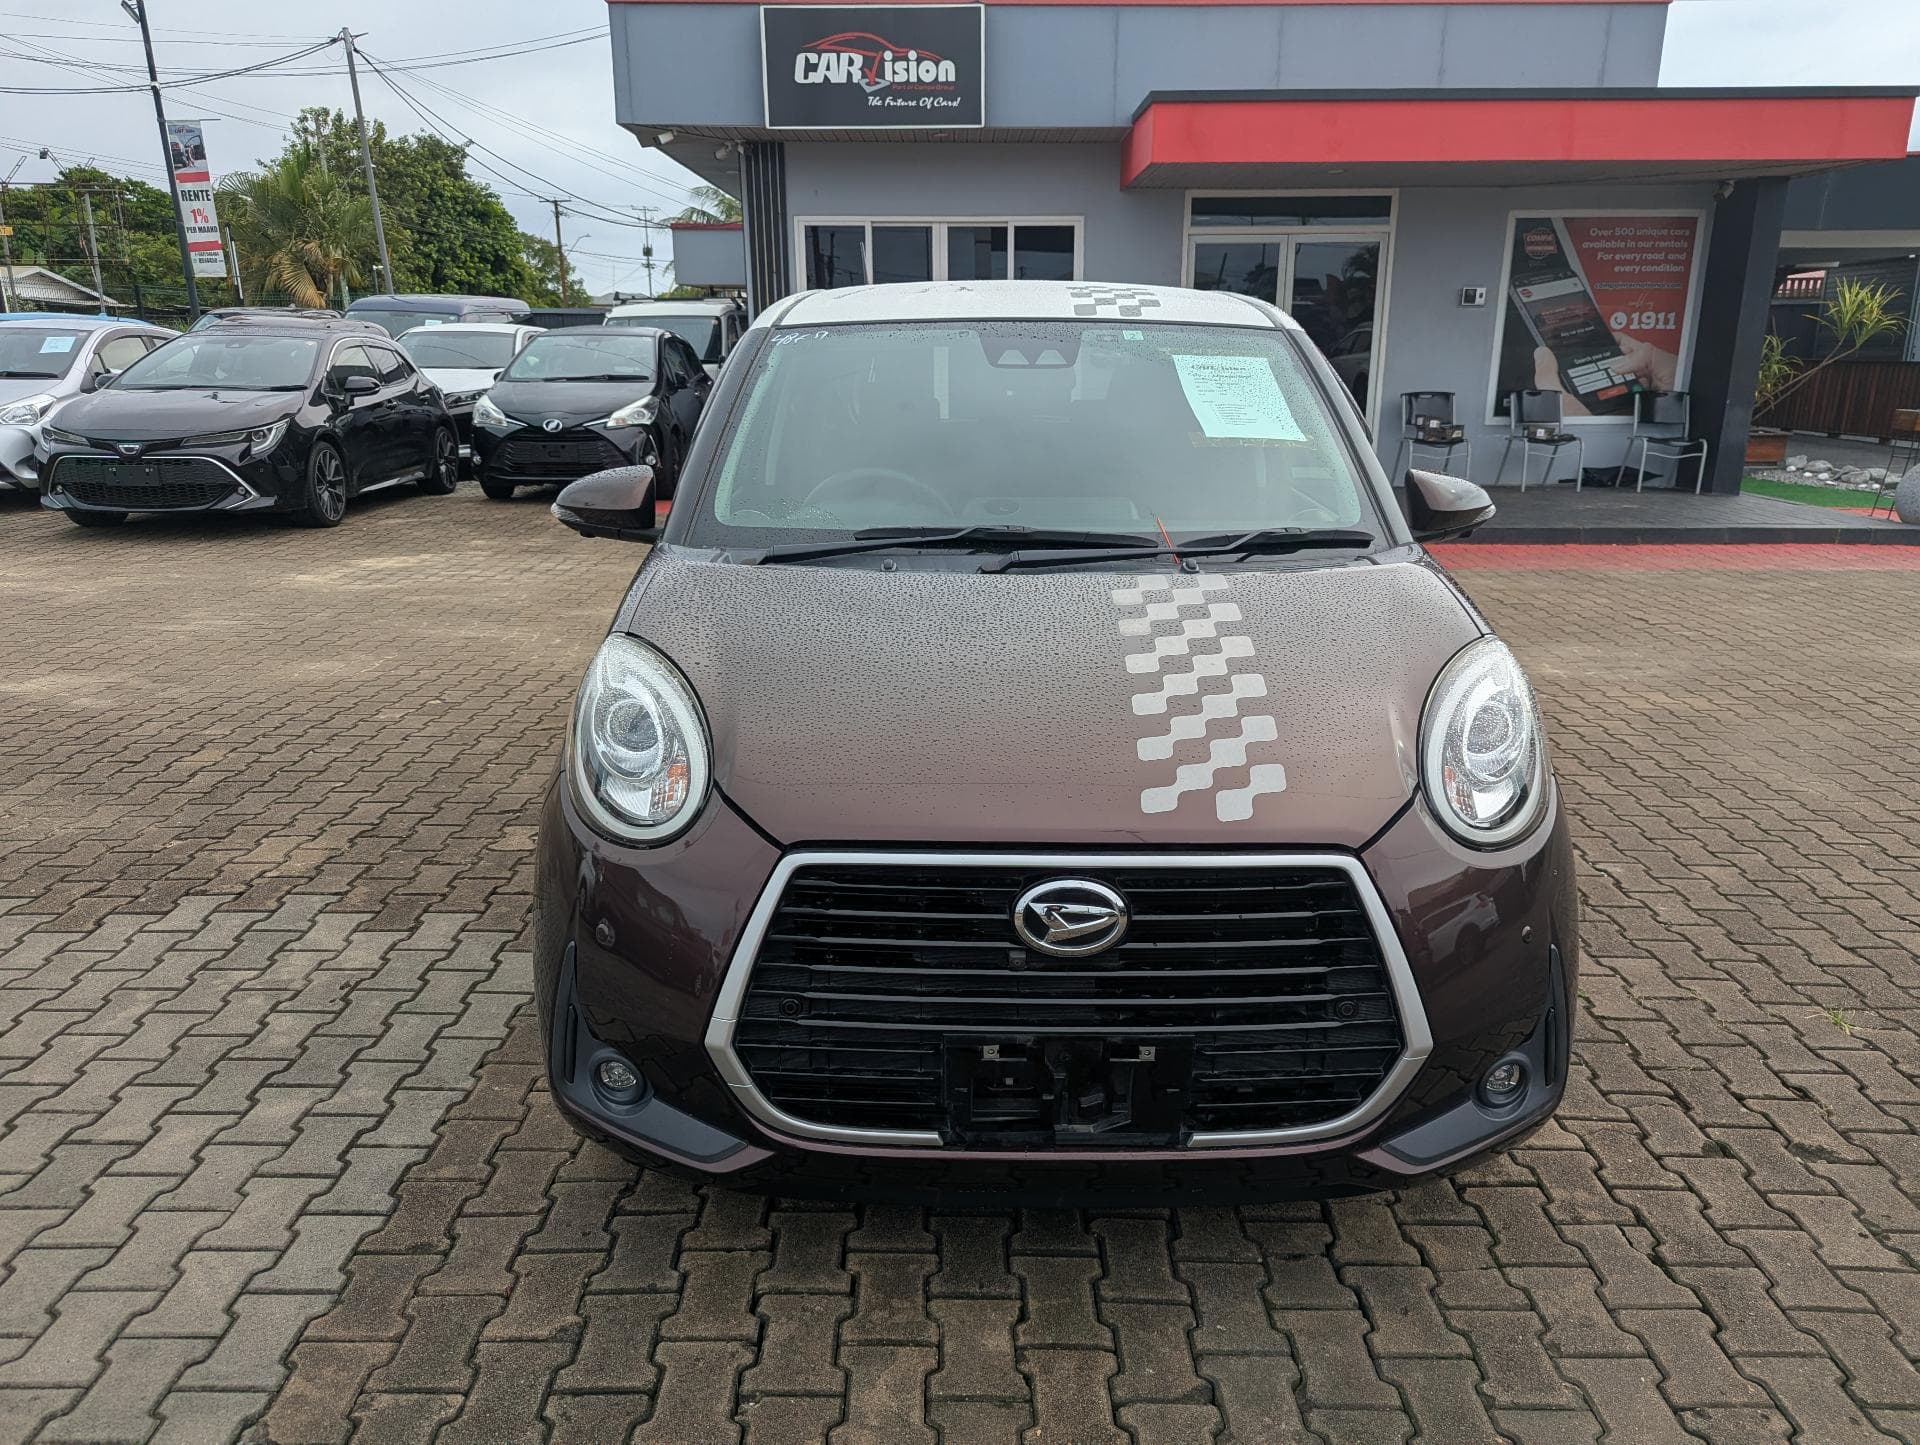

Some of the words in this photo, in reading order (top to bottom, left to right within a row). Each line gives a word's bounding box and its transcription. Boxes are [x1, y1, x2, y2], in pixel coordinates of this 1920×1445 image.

[867, 96, 883, 107] The
[885, 96, 917, 107] Future
[919, 97, 933, 109] Of
[180, 190, 211, 201] RENTE
[190, 208, 208, 223] 1%
[1590, 227, 1613, 236] Over
[1615, 227, 1635, 236] 500
[1637, 228, 1668, 237] unique
[1582, 240, 1625, 249] available
[1627, 240, 1635, 248] in
[1655, 240, 1688, 248] rentals
[1597, 252, 1614, 261] For
[1615, 253, 1641, 261] every
[1642, 252, 1665, 260] road
[1667, 252, 1687, 260] and
[1614, 264, 1640, 274] every
[1641, 264, 1684, 272] condition
[1629, 312, 1676, 330] 1911
